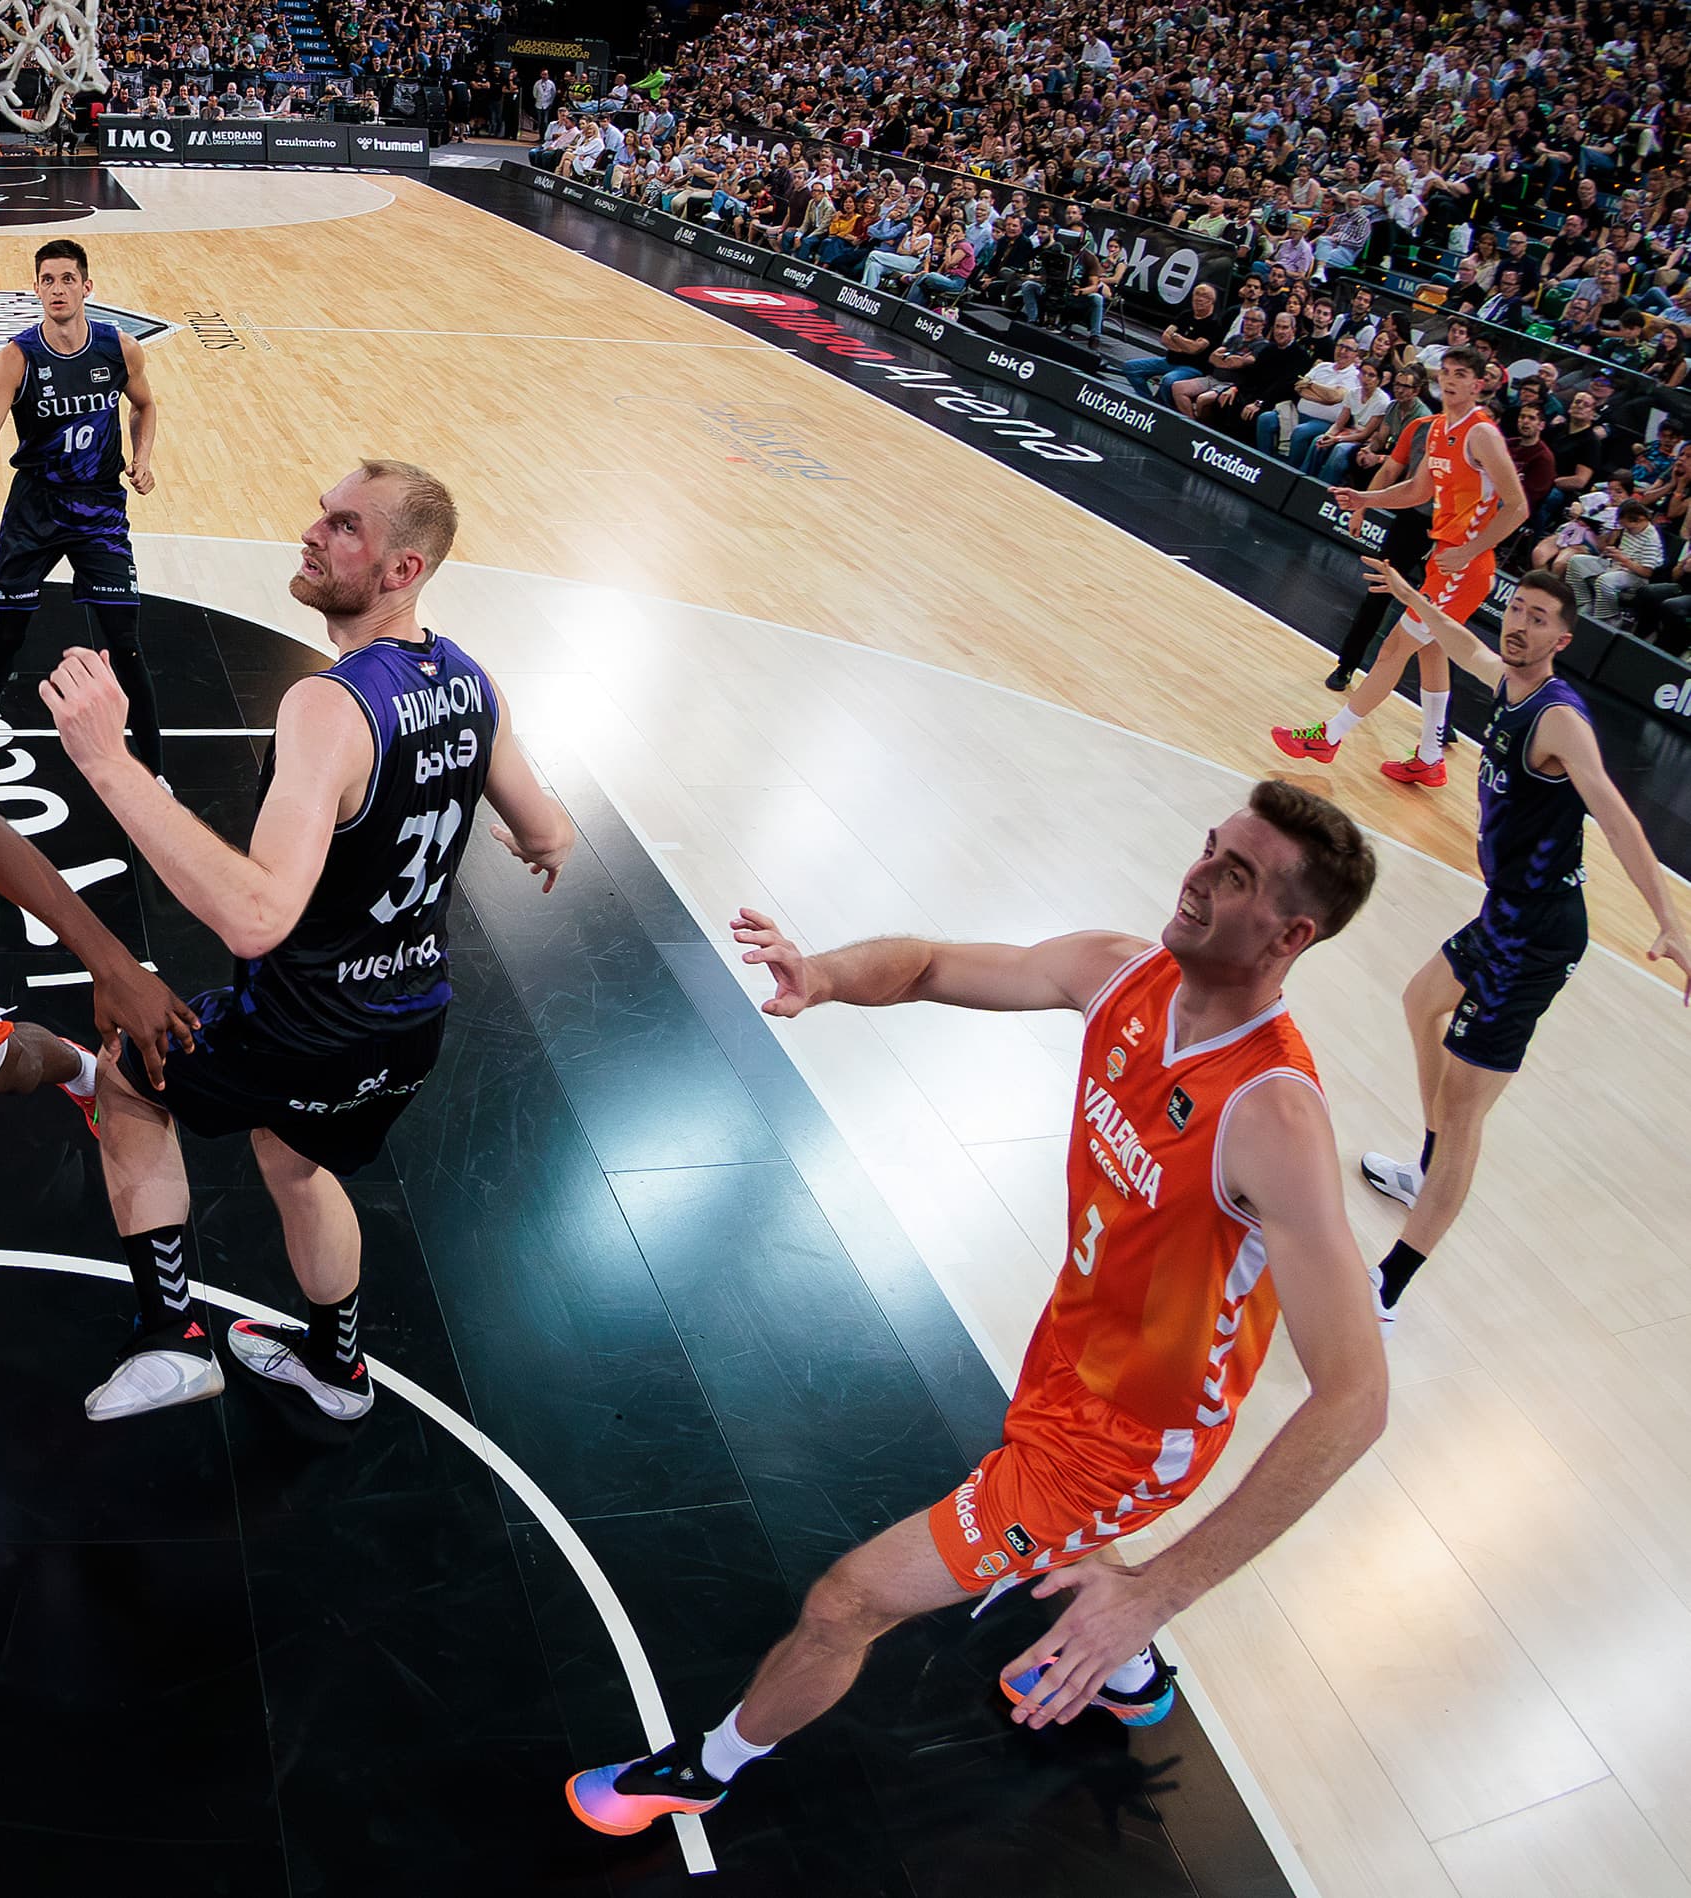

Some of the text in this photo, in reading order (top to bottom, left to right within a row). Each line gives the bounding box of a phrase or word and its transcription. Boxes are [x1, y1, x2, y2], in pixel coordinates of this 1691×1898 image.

[107, 129, 175, 152] IMQ
[212, 131, 263, 140] MEDRANO
[275, 137, 337, 148] azulmarino
[373, 137, 424, 153] hummel
[716, 245, 755, 265] NISSAN
[837, 285, 882, 316] Bilbobus
[37, 389, 120, 418] surne
[854, 360, 1104, 463] Arena
[1076, 383, 1157, 434] kutxabank
[63, 424, 95, 453] 10
[1203, 445, 1262, 485] Occident
[92, 585, 126, 593] NISSAN
[1084, 1076, 1164, 1209] VALENCIA
[1073, 1203, 1105, 1277] 3
